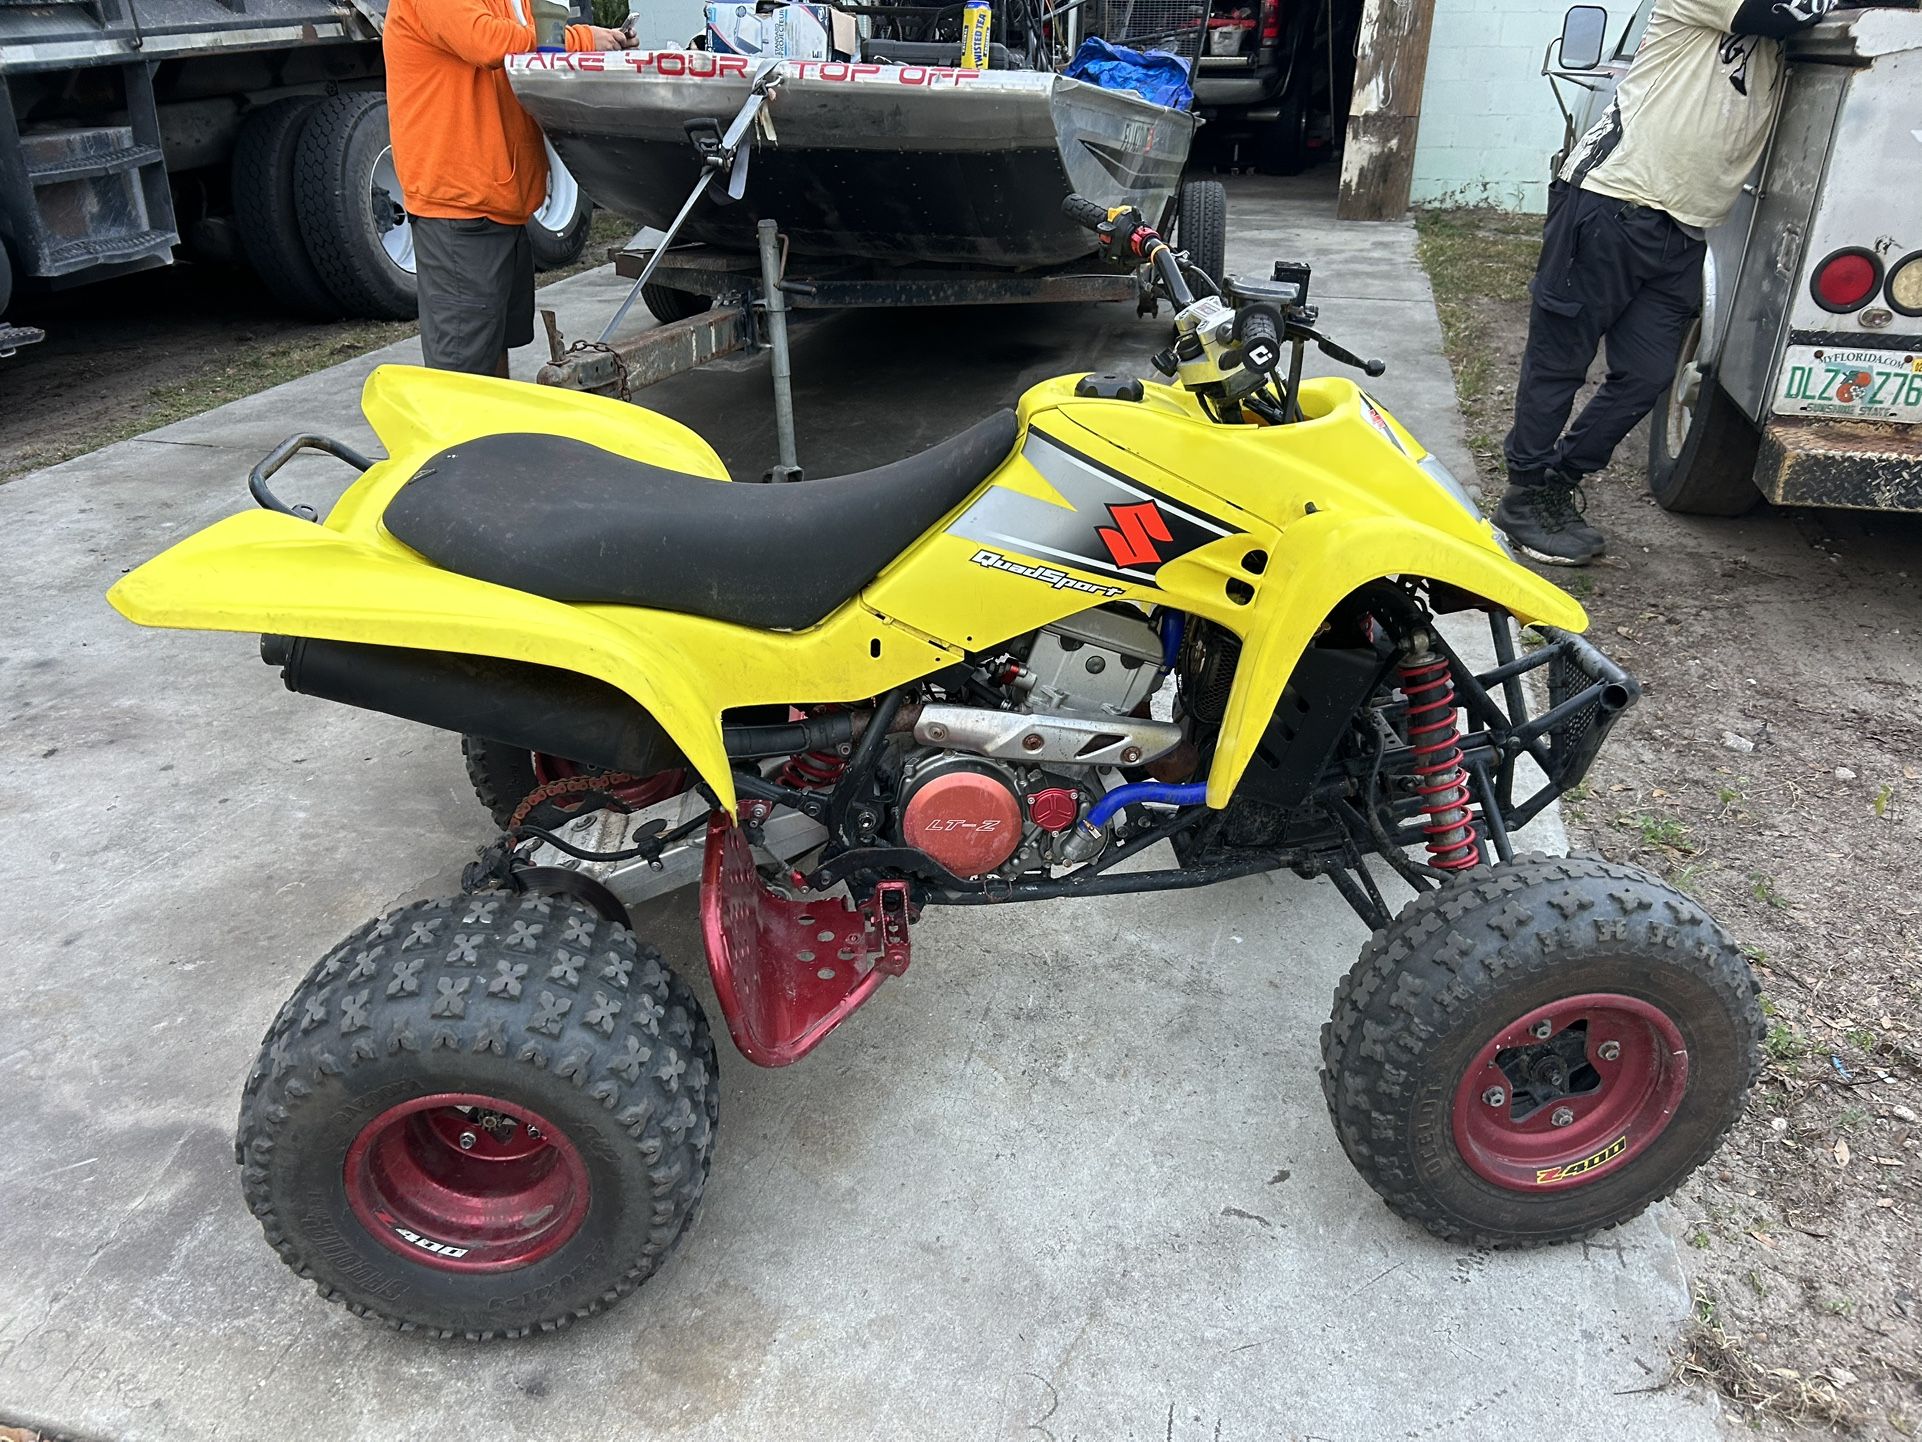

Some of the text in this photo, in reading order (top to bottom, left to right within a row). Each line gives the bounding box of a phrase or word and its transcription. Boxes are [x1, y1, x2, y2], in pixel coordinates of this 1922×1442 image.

[974, 13, 986, 68] TWISTED TEA
[508, 51, 981, 86] TAKE YOUR TOP OFF
[1784, 366, 1922, 407] DLZ Z76
[1806, 402, 1891, 417] SUNSHINE STATE
[970, 549, 1126, 597] QuadSport
[925, 819, 1001, 832] LT-Z
[1536, 1135, 1627, 1184] Z400
